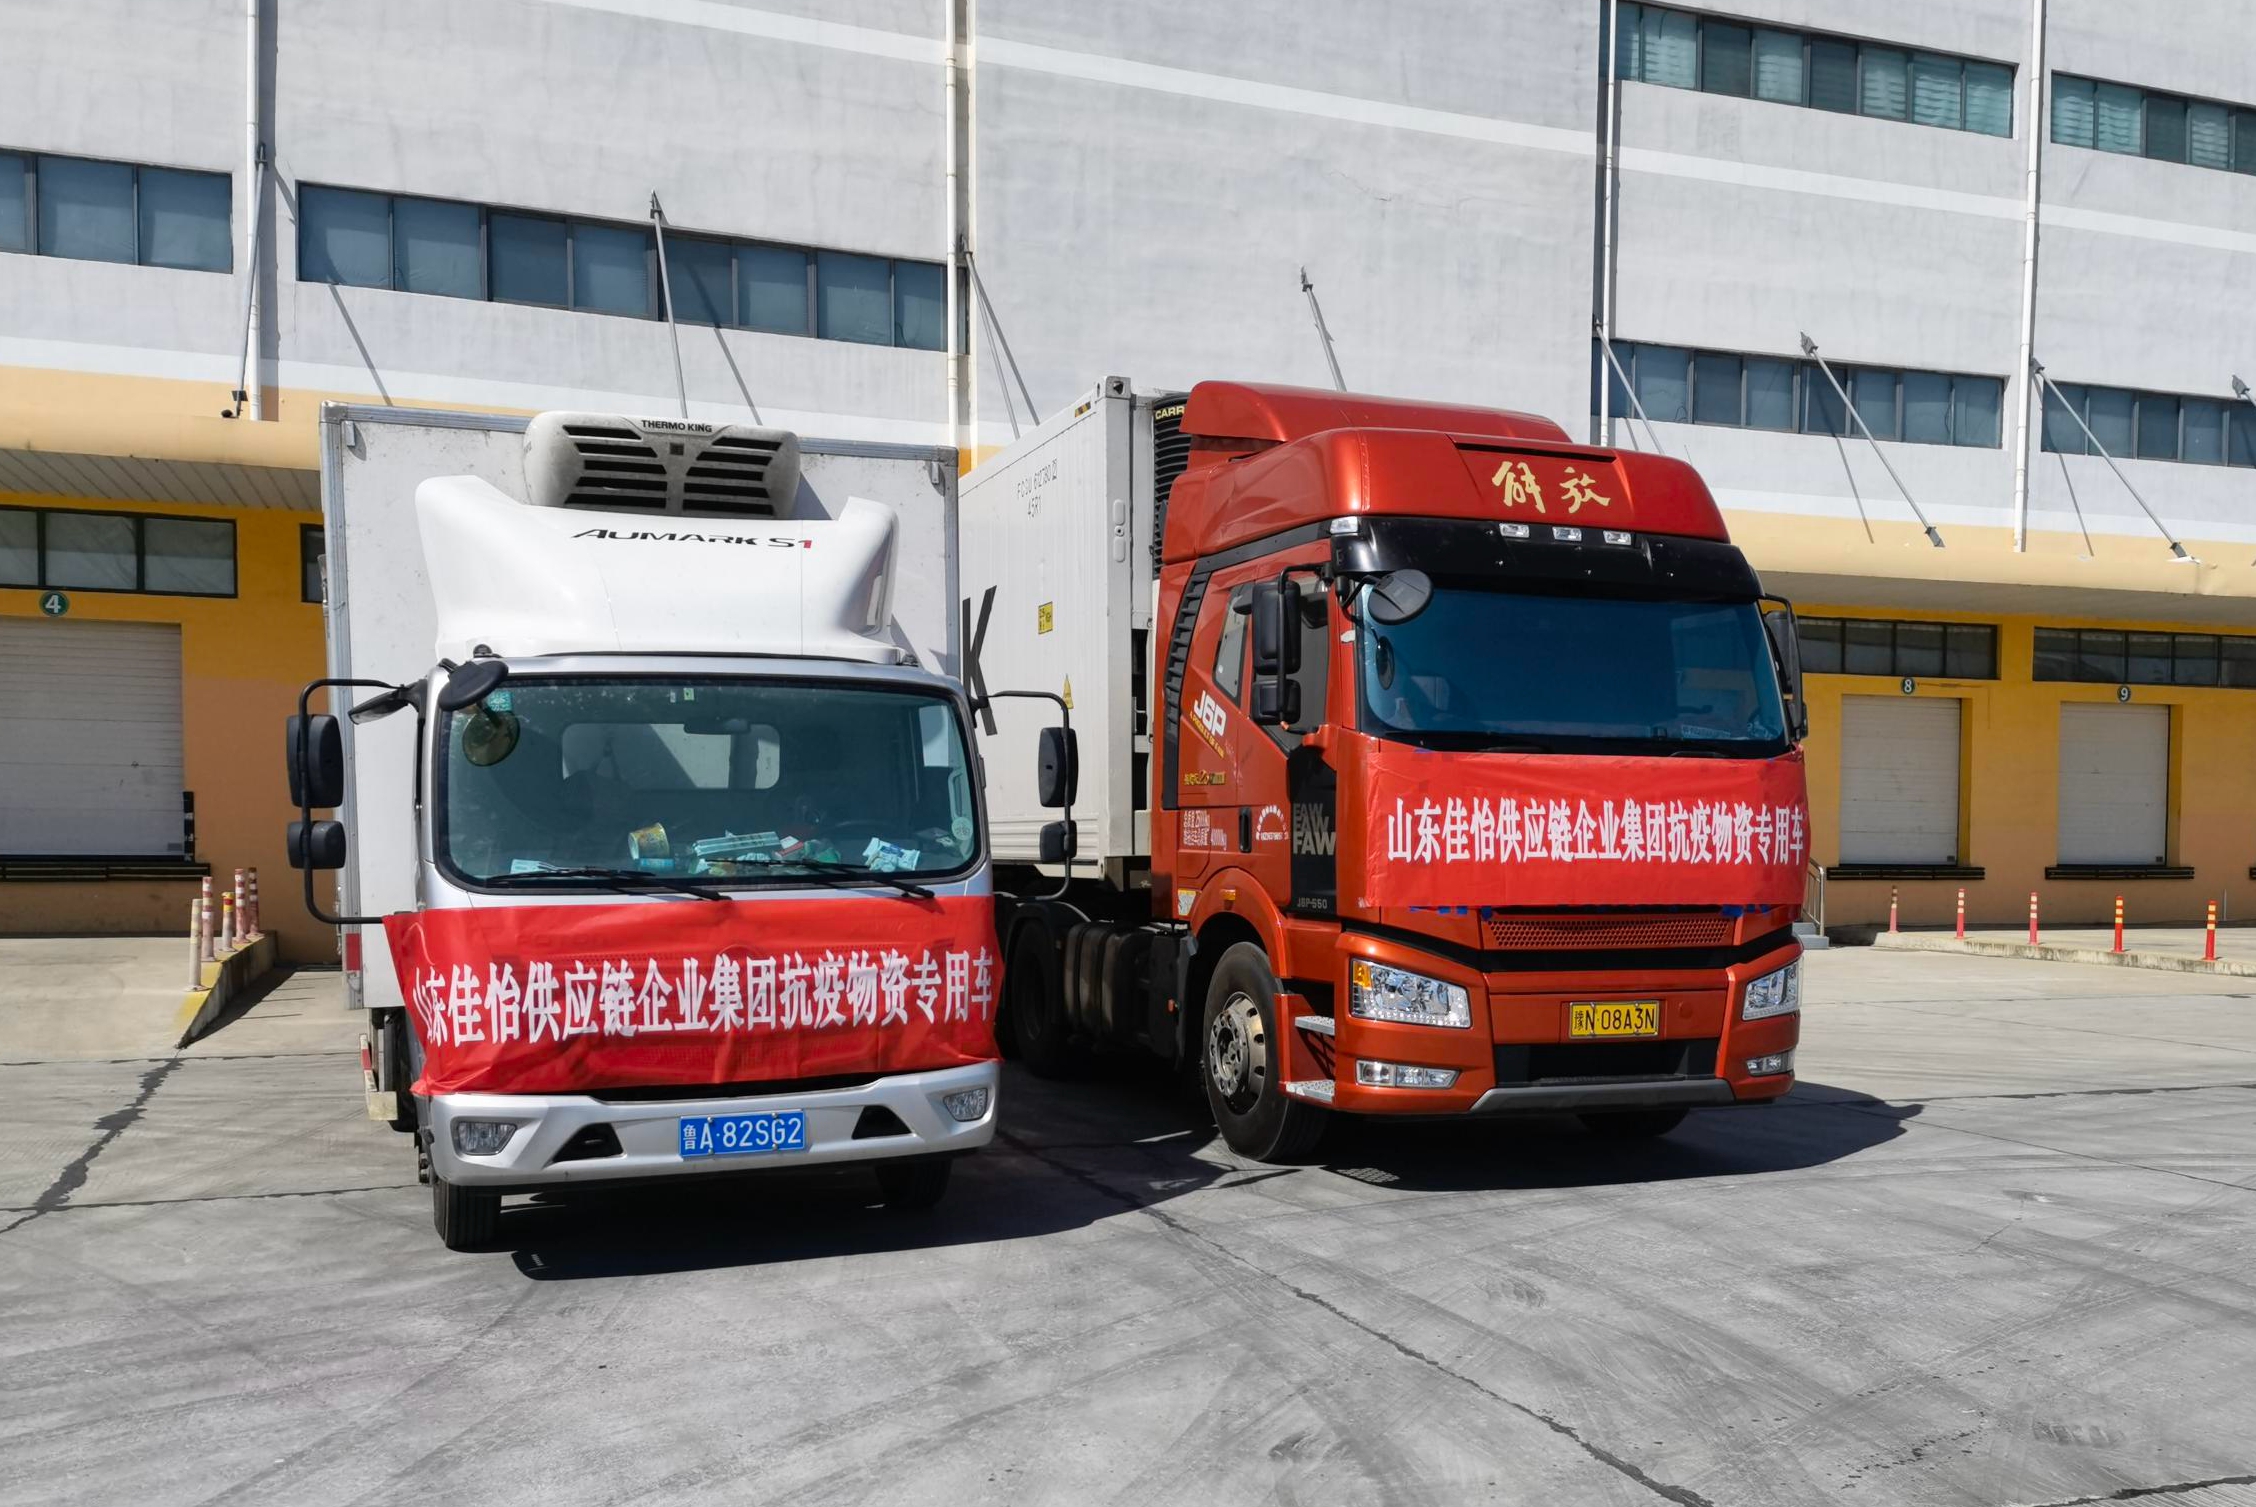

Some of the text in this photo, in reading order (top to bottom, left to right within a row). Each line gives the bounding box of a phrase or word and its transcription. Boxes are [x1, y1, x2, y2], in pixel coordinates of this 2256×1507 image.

[641, 420, 712, 432] THERMO KING
[1492, 460, 1611, 514] 解放
[571, 528, 812, 549] AUMARK S1
[45, 594, 61, 614] 4
[962, 584, 998, 736] K
[1903, 678, 1913, 693] 8
[2120, 688, 2129, 701] 9
[1193, 689, 1226, 737] J6P
[1293, 831, 1337, 855] FAW
[1387, 797, 1804, 866] 山东佳怡供应链企业集团抗疫物资专用车
[682, 1117, 802, 1151] 鲁A·82SG2
